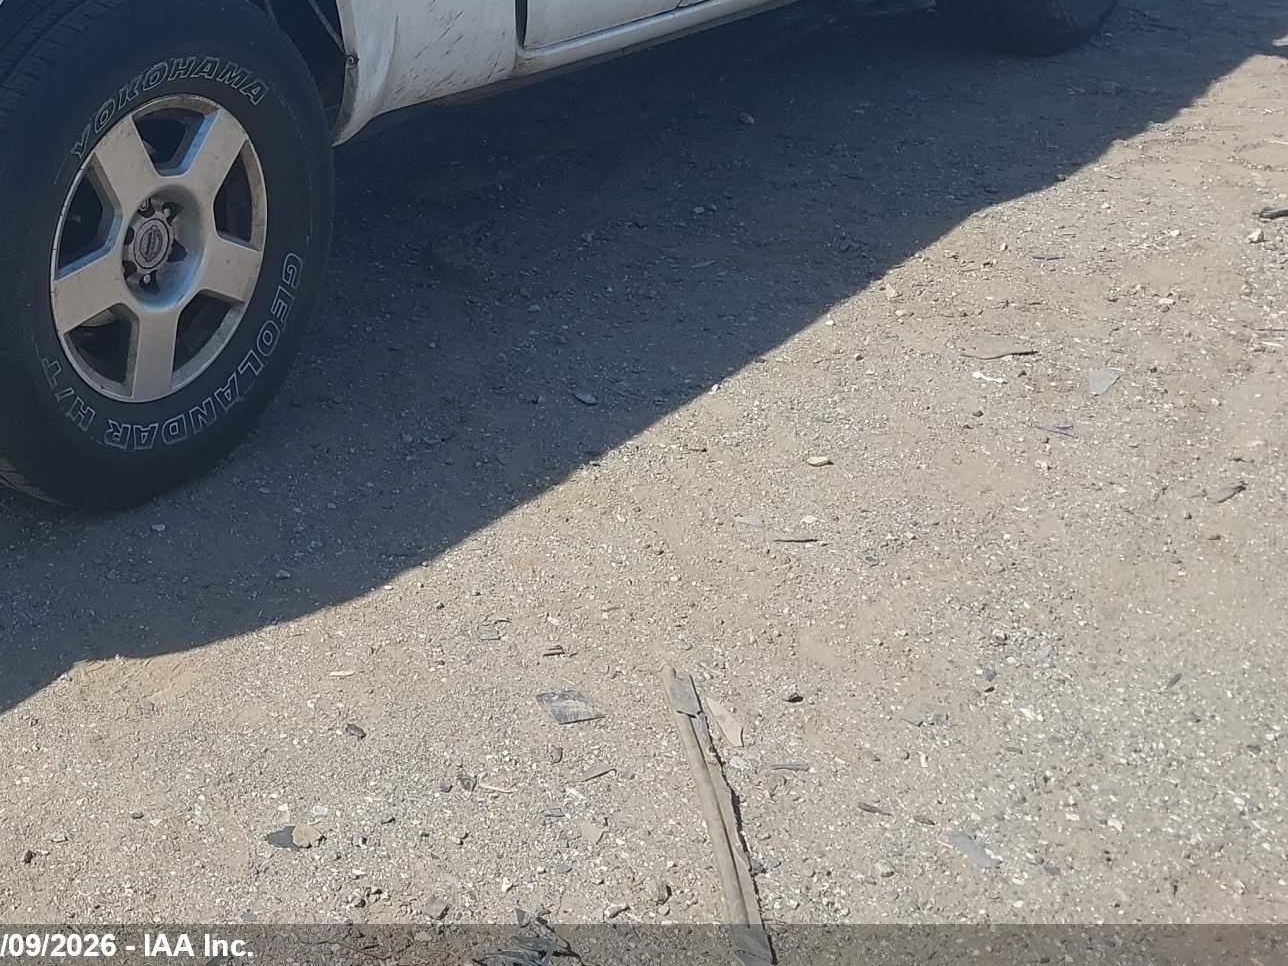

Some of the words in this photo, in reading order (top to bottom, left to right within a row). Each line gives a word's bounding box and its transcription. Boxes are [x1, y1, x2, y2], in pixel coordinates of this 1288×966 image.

[71, 56, 270, 160] YOKOHAMA
[40, 356, 97, 433] H/T
[104, 251, 304, 451] GEOLANDAR
